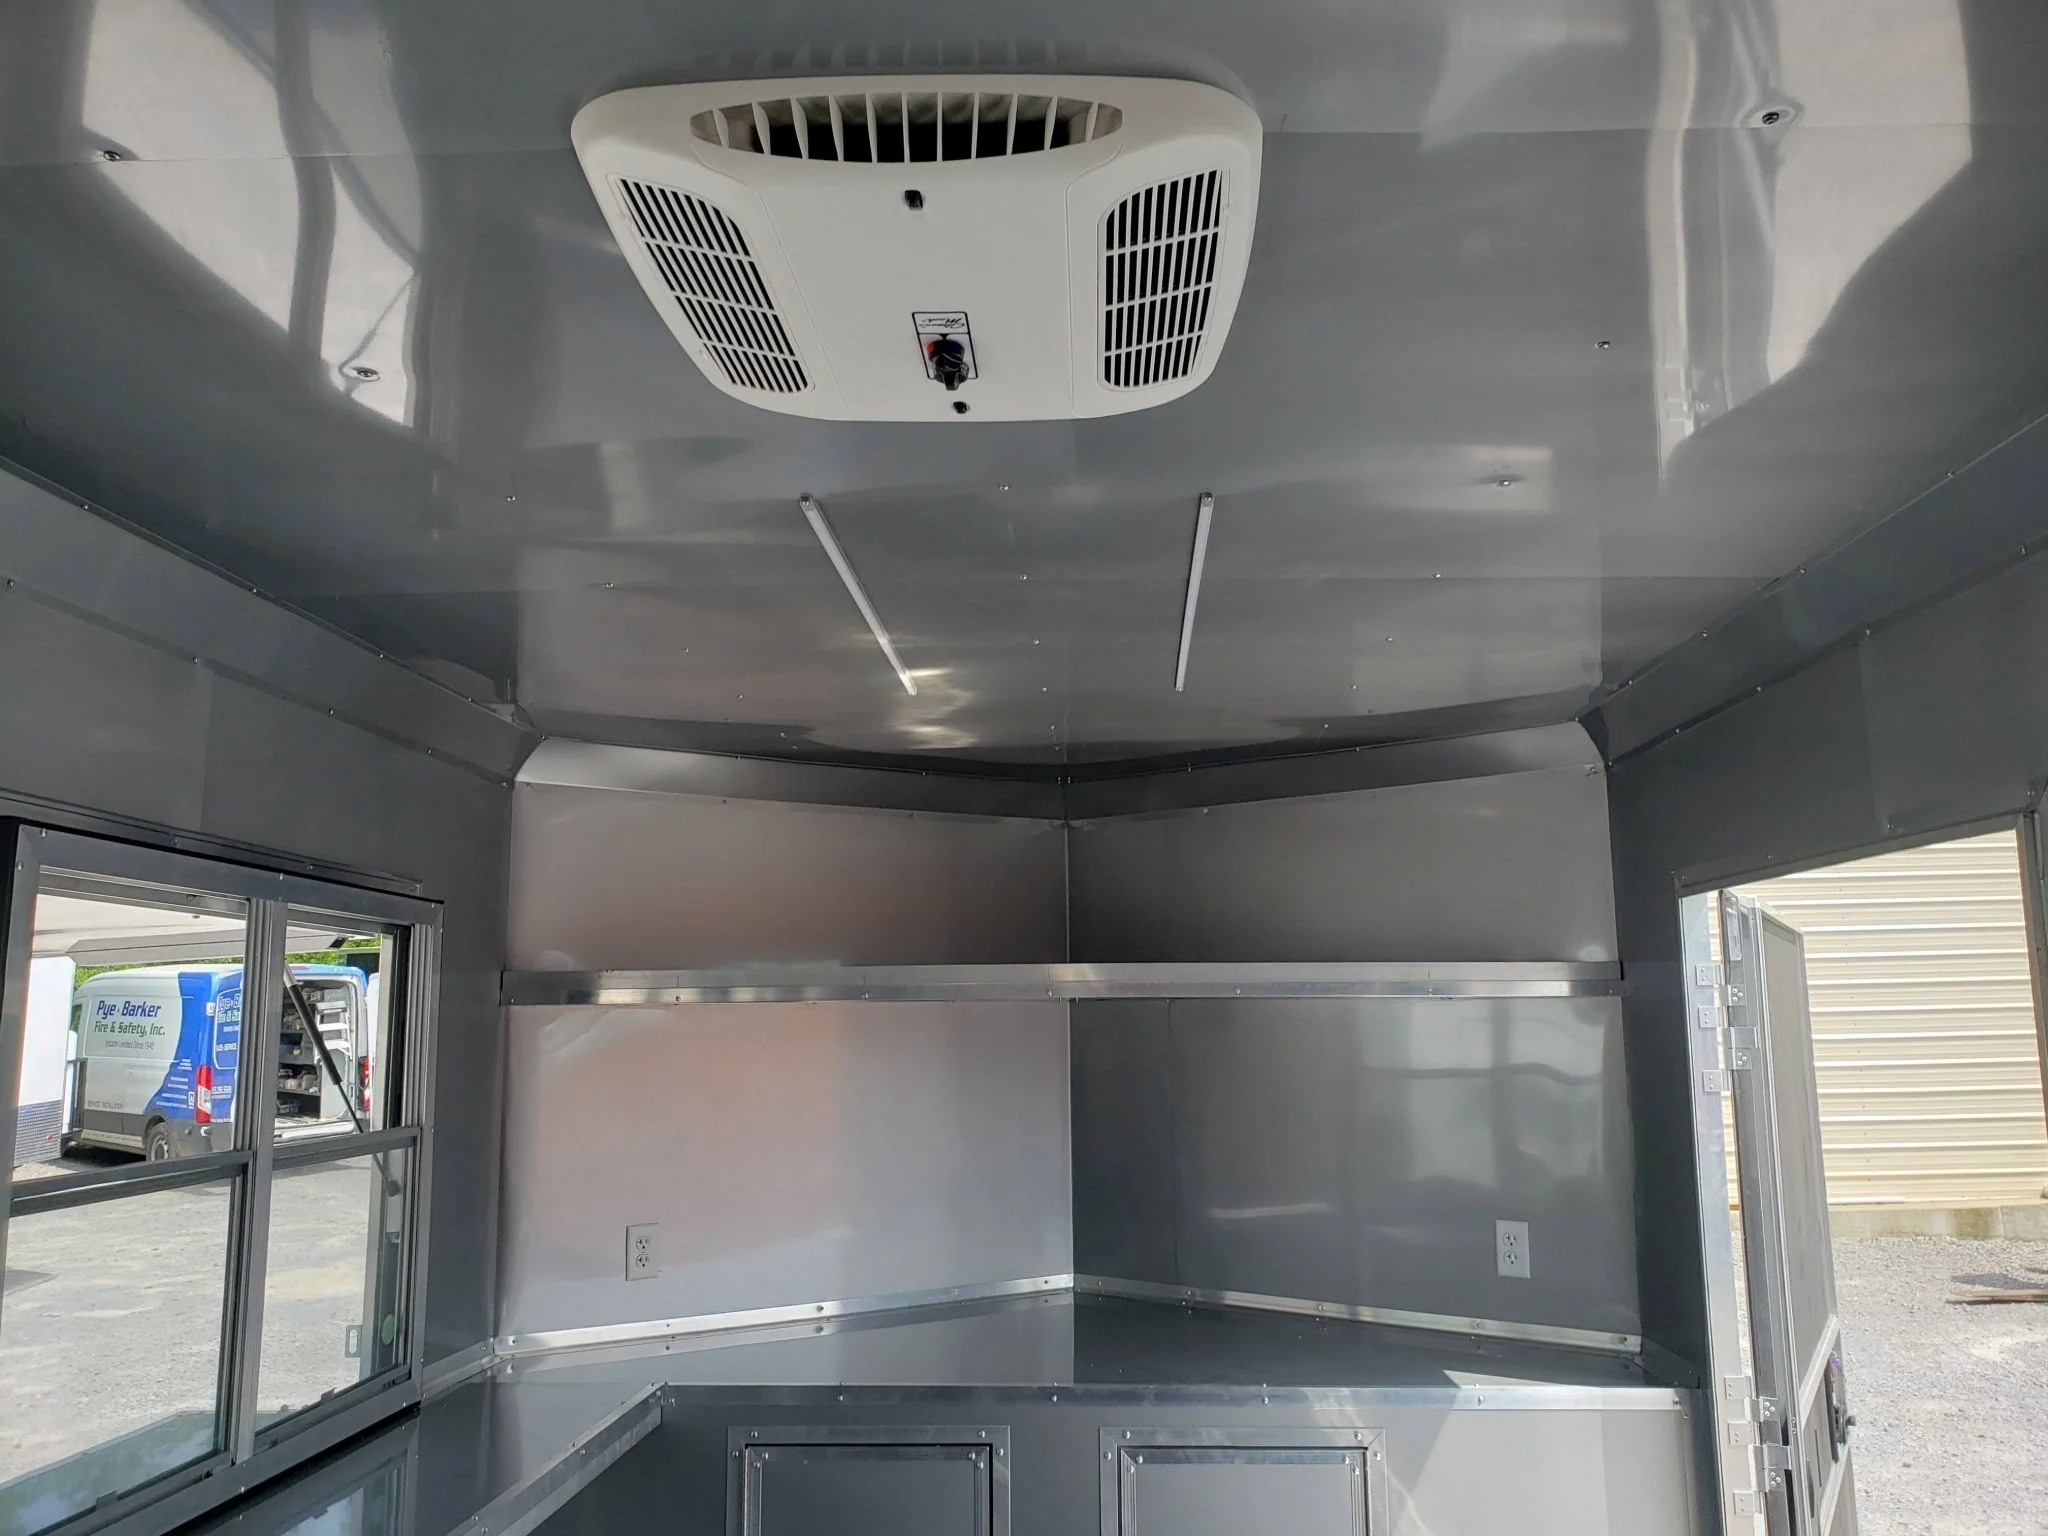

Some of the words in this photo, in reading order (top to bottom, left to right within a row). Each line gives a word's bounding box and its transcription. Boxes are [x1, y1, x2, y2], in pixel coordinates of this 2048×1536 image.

[96, 1000, 117, 1020] Pye
[121, 1000, 162, 1018] Barker
[94, 1020, 109, 1033] Fire
[109, 1021, 116, 1033] &
[117, 1021, 148, 1038] Safety,
[149, 1023, 166, 1036] Inc.
